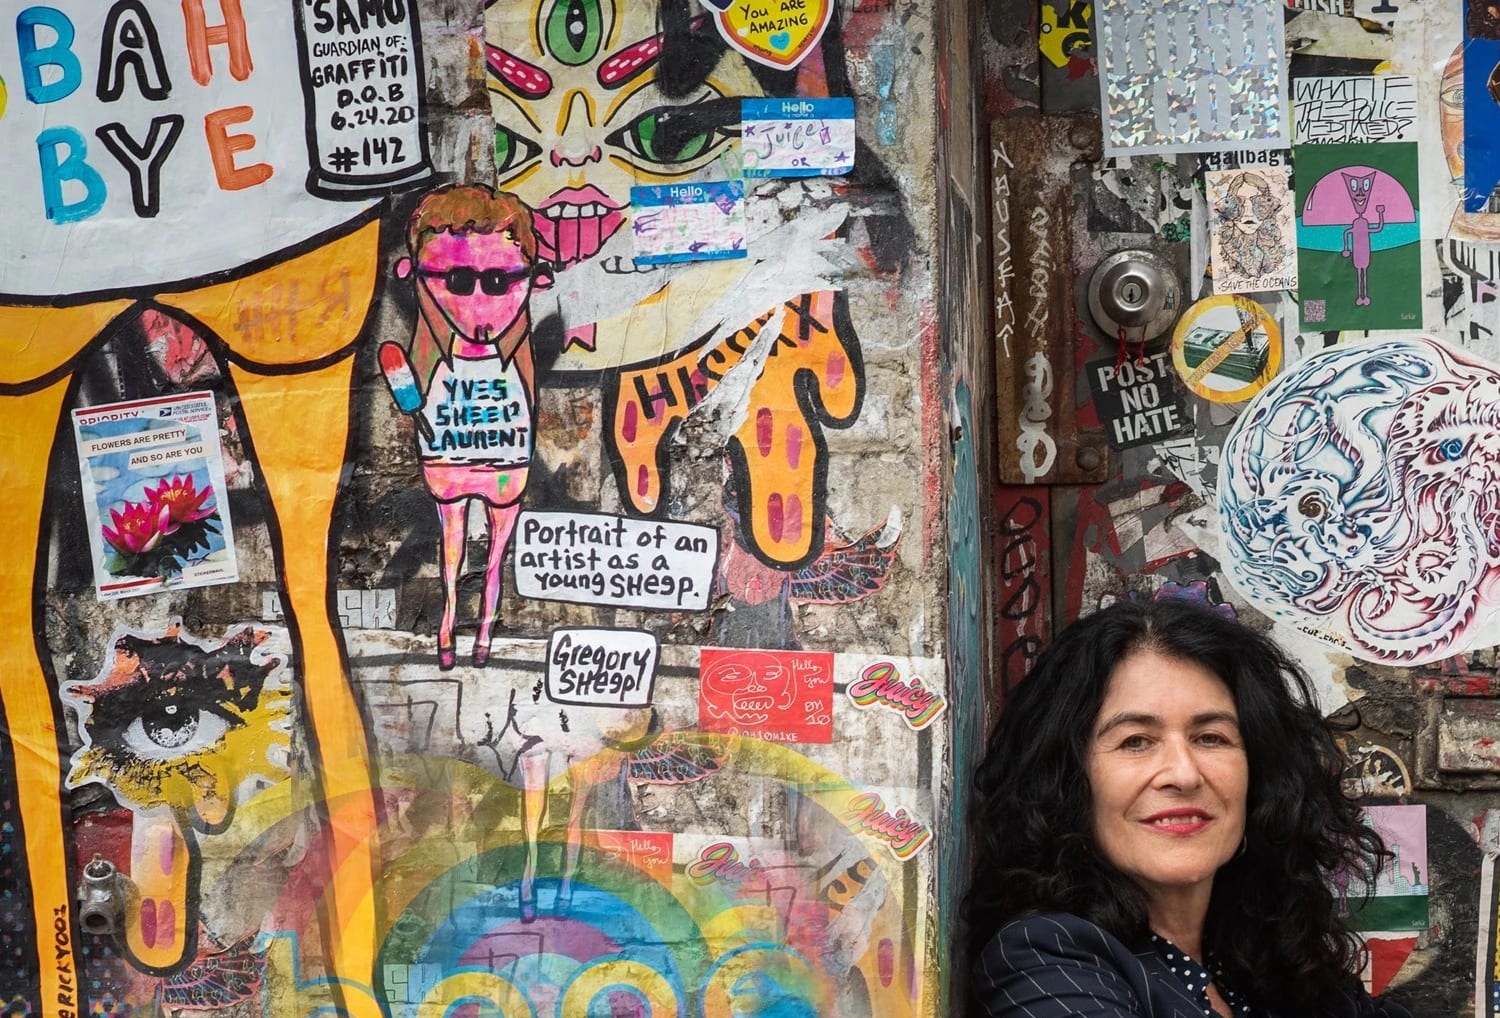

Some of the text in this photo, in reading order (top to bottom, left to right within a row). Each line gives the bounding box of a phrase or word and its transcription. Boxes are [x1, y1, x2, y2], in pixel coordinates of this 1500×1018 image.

[313, 0, 405, 34] SAMO
[741, 0, 806, 20] You ARE
[750, 13, 810, 34] AMAZING
[17, 0, 254, 104] BAH
[313, 38, 380, 58] GUARDIAN
[312, 50, 409, 88] GRAFFITI
[337, 84, 405, 108] D.O.B
[1297, 78, 1372, 101] WHAT
[331, 106, 415, 130] 6.24.20
[782, 102, 815, 113] Hello
[37, 105, 274, 225] BYE
[328, 137, 407, 172] #142
[791, 157, 811, 167] OR
[1208, 150, 1281, 167] Ballbag
[670, 185, 703, 198] Hello
[1219, 276, 1297, 292] SAVE THE OCEANS
[1097, 352, 1167, 392] POST
[442, 378, 507, 402] YVES
[1120, 383, 1160, 414] NO
[1113, 405, 1180, 444] HATE
[92, 430, 186, 452] FLOWERS ARE PRETTY
[131, 446, 203, 465] AND SO ARE YOU
[524, 518, 708, 554] Portrait of an
[521, 548, 670, 571] artist as a
[535, 570, 605, 598] young
[553, 635, 652, 684] Gregory
[849, 661, 947, 727] Juicy
[846, 792, 931, 858] Juicy
